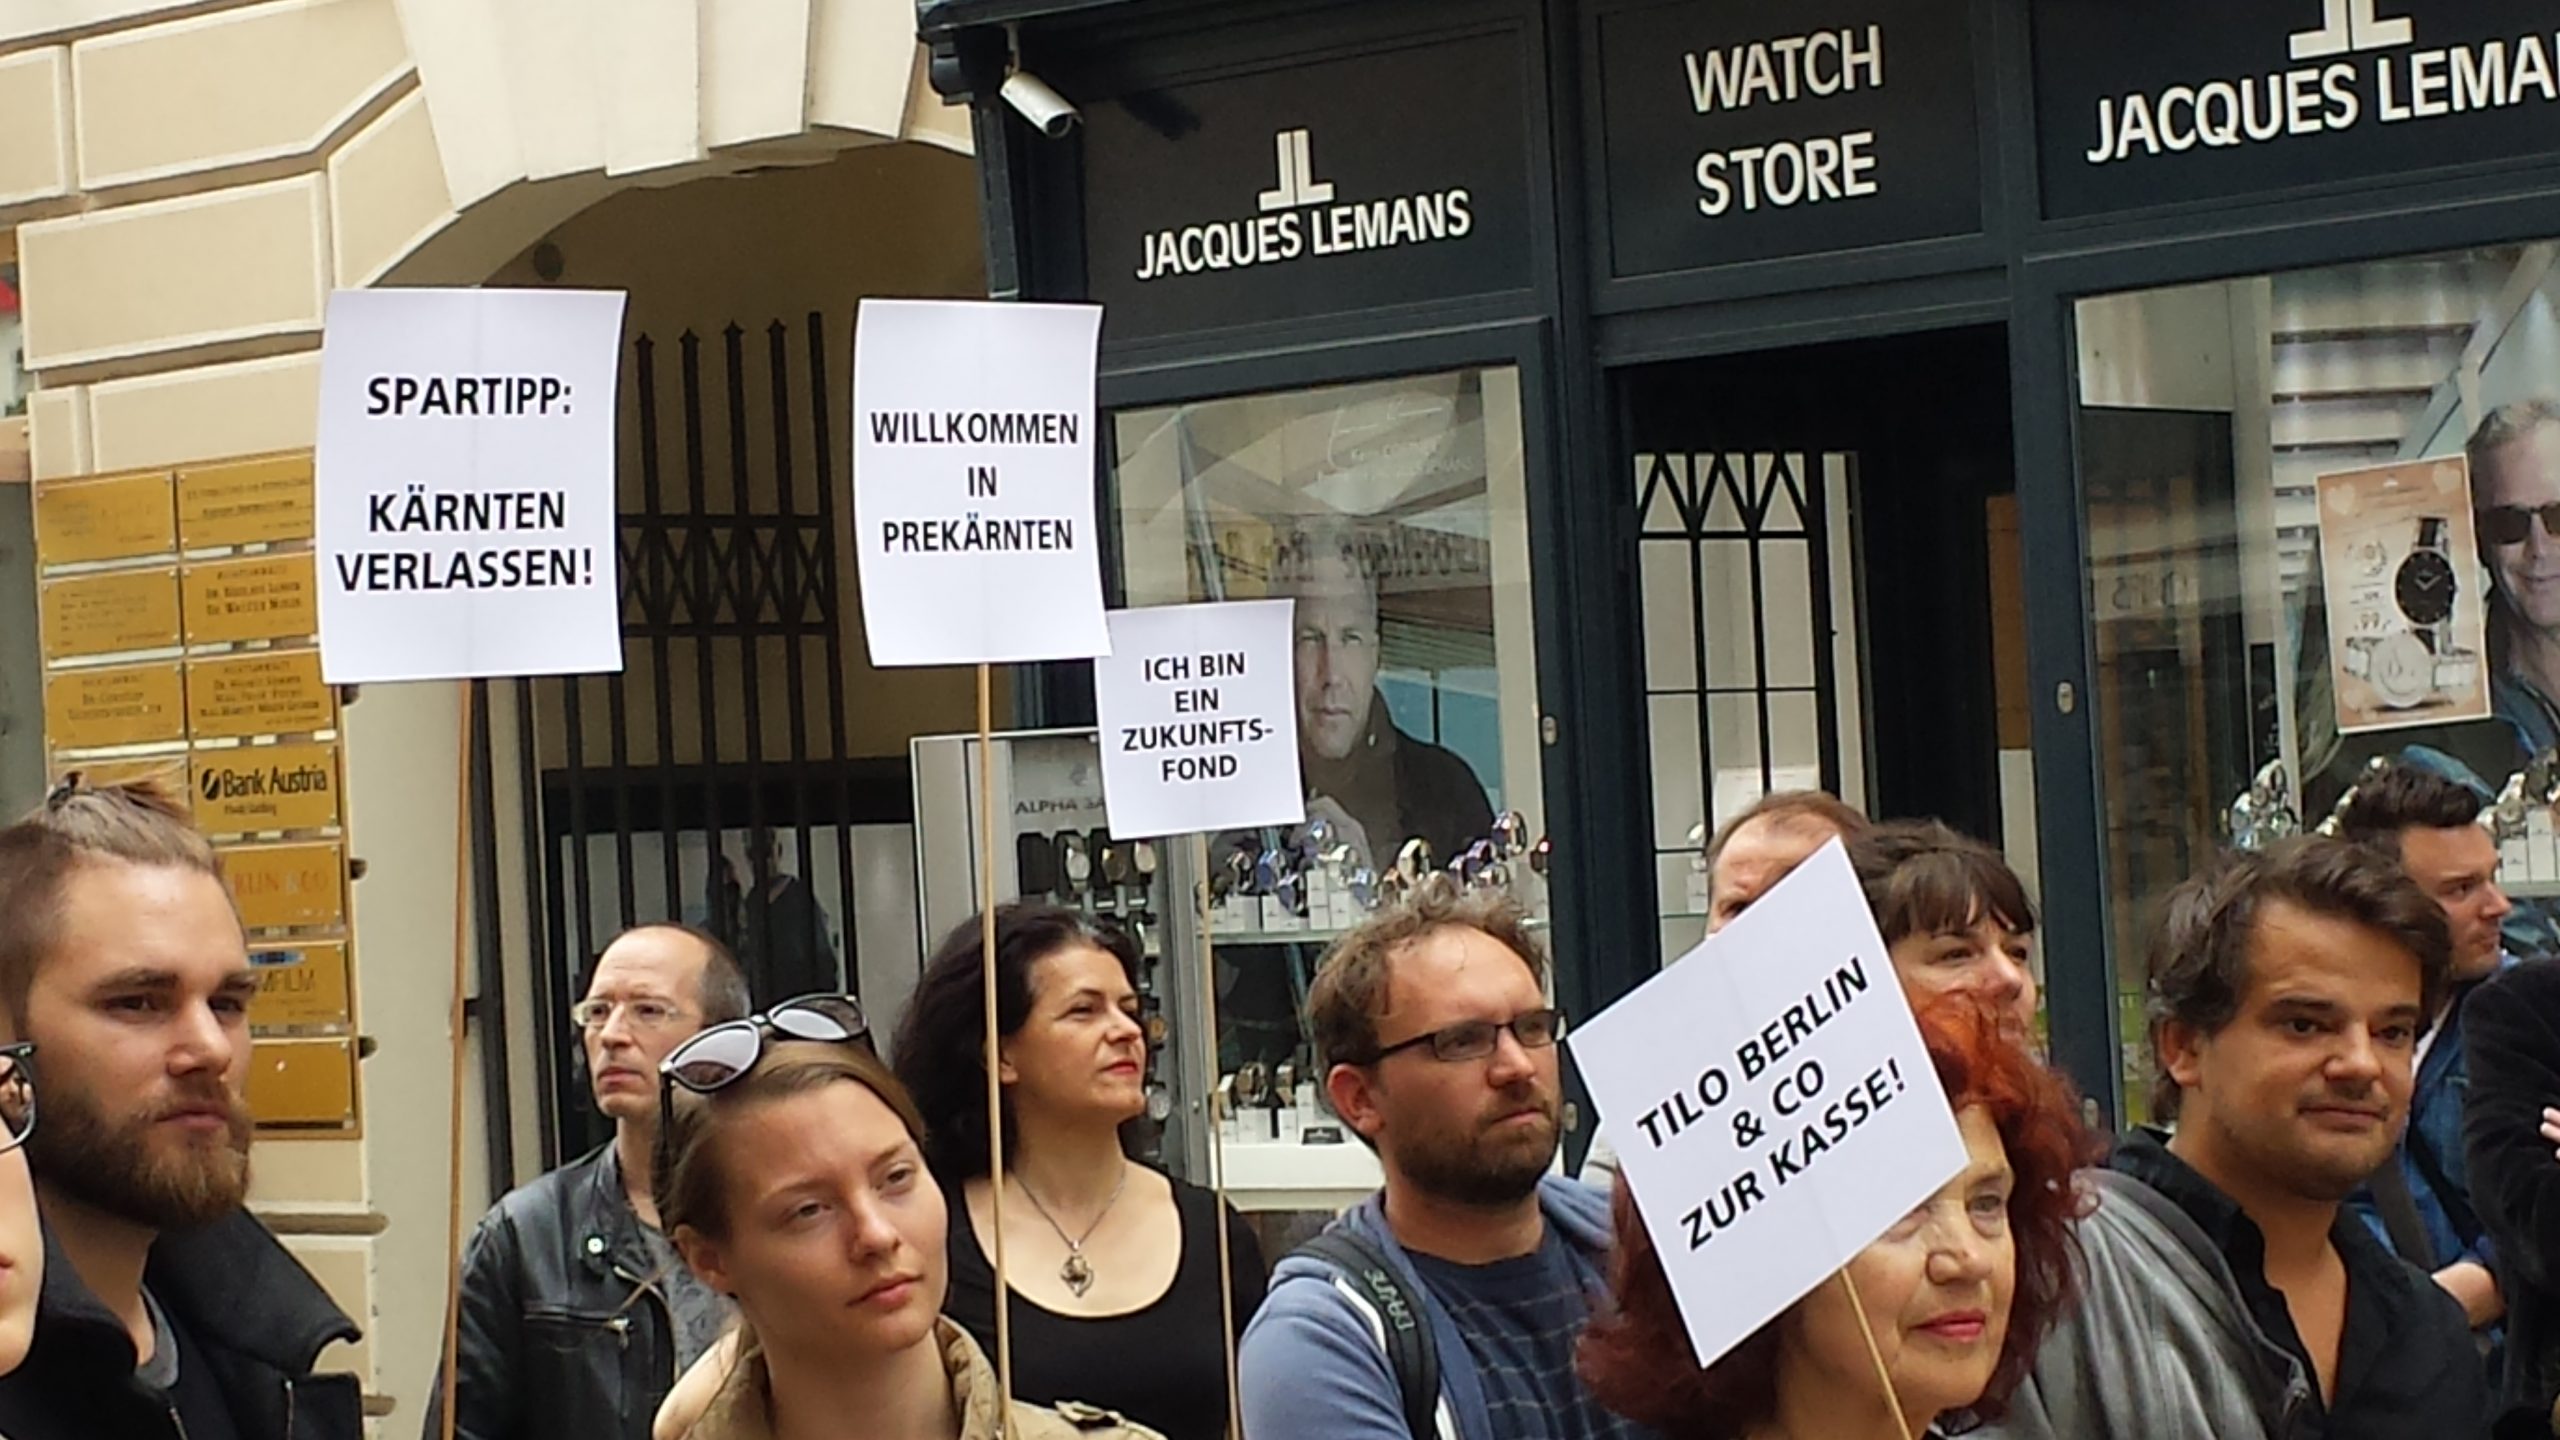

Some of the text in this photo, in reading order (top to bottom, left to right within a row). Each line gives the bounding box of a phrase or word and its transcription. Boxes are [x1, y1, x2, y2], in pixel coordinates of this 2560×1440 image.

[1684, 25, 1882, 113] WATCH
[2087, 31, 2560, 163] JACQUES LEMA
[1696, 131, 1878, 215] STORE
[1136, 190, 1471, 279] JACQUES LEMANS
[366, 376, 572, 416] SPARTIPP:
[870, 411, 1079, 445] WILLKOMMEN
[967, 465, 998, 498] IN
[368, 483, 565, 533] KÄRNTEN
[882, 511, 1074, 553] PREKÄRNTEN
[335, 548, 593, 592] VERLASSEN!
[1144, 651, 1245, 683] ICH BIN
[1174, 687, 1219, 713] EIN
[1121, 717, 1274, 752] ZUKUNFTS-
[222, 764, 328, 799] Bank Austria
[1161, 754, 1238, 783] FOND
[1014, 799, 1078, 815] ALPHA
[301, 869, 329, 894] CO
[1635, 956, 1869, 1150] TILO BERLIN
[1732, 1059, 1825, 1149] & CO
[1679, 1057, 1905, 1251] ZUR KASSE!
